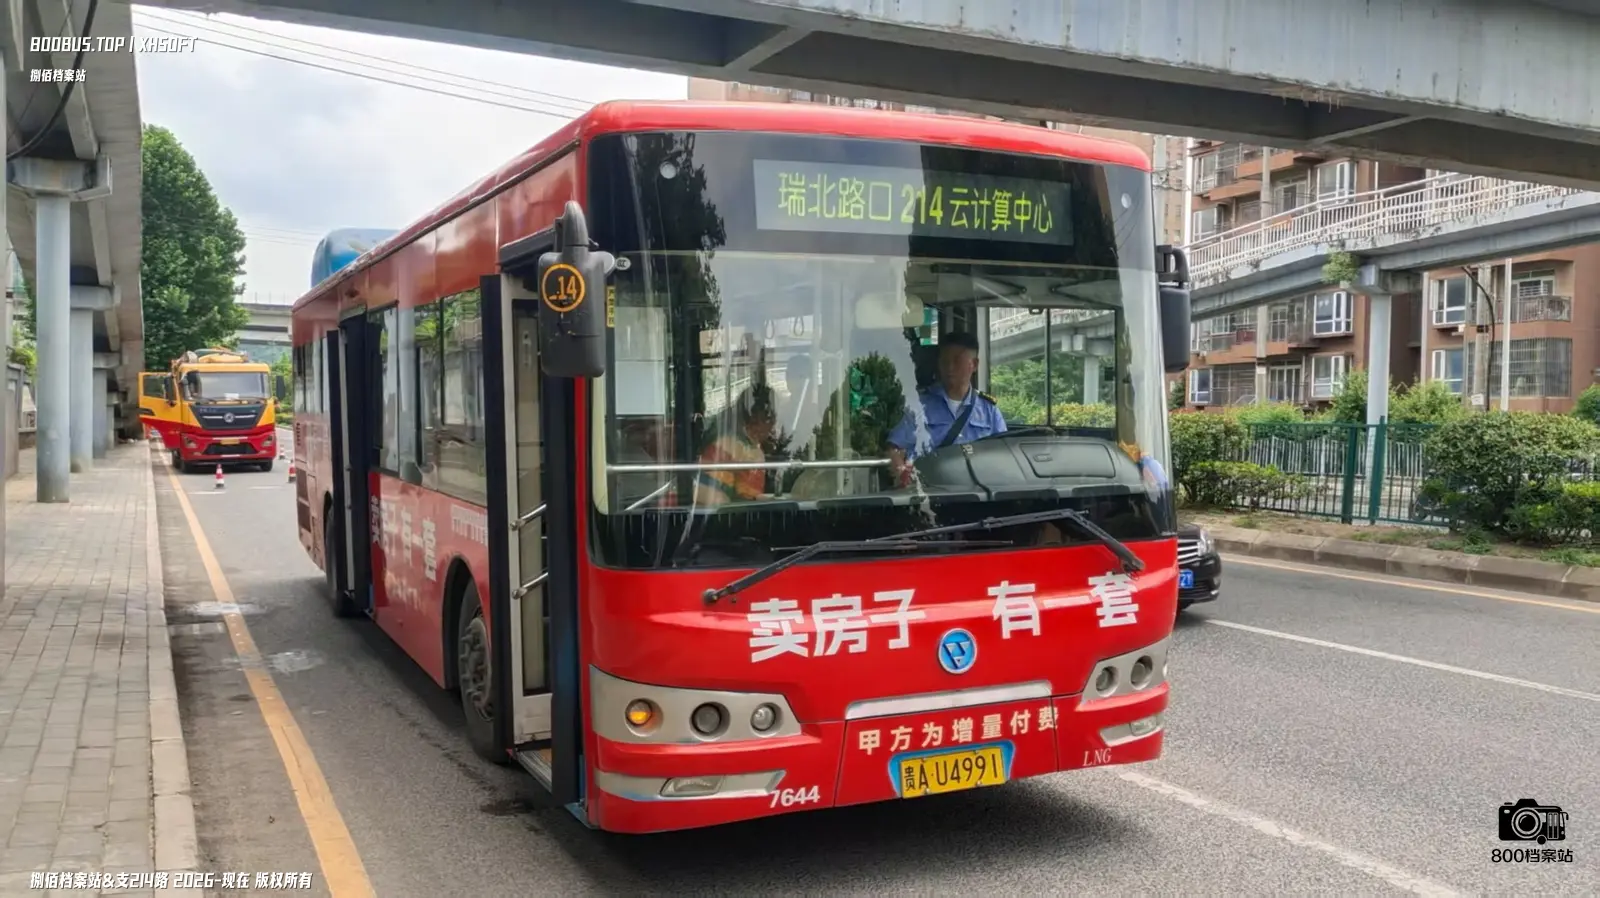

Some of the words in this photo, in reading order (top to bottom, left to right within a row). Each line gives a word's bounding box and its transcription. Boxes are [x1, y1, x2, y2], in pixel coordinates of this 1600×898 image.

[777, 172, 892, 222] 瑞北路口
[900, 185, 943, 226] 214
[949, 188, 1053, 234] 云计算中心
[548, 275, 578, 301] 14
[747, 588, 926, 663] 卖房子
[986, 571, 1140, 639] 有一套
[858, 706, 1059, 755] 甲方为增量付费
[1082, 747, 1112, 767] LNG
[769, 785, 821, 808] 7644
